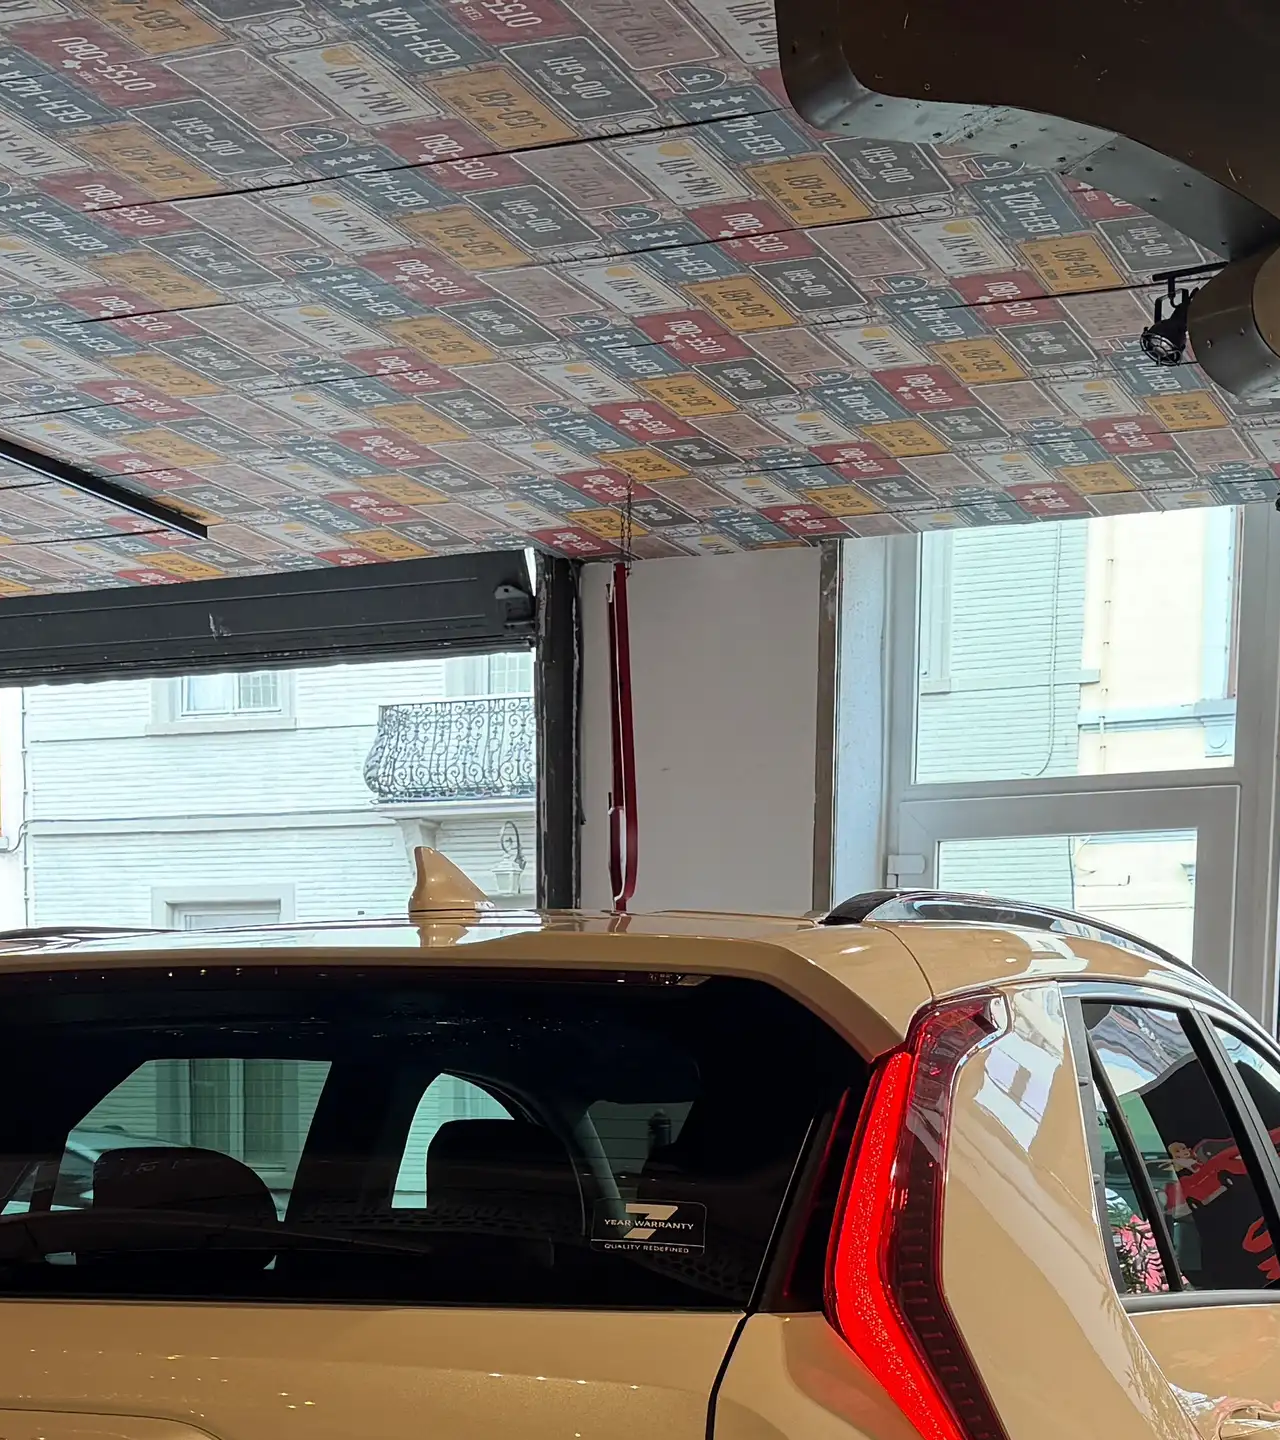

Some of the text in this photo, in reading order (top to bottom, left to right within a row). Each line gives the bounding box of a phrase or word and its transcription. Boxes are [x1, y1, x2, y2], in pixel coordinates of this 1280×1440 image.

[676, 72, 717, 85] 15
[605, 1219, 694, 1230] YEAR WARRANTY
[643, 1245, 689, 1254] REDEFINED
